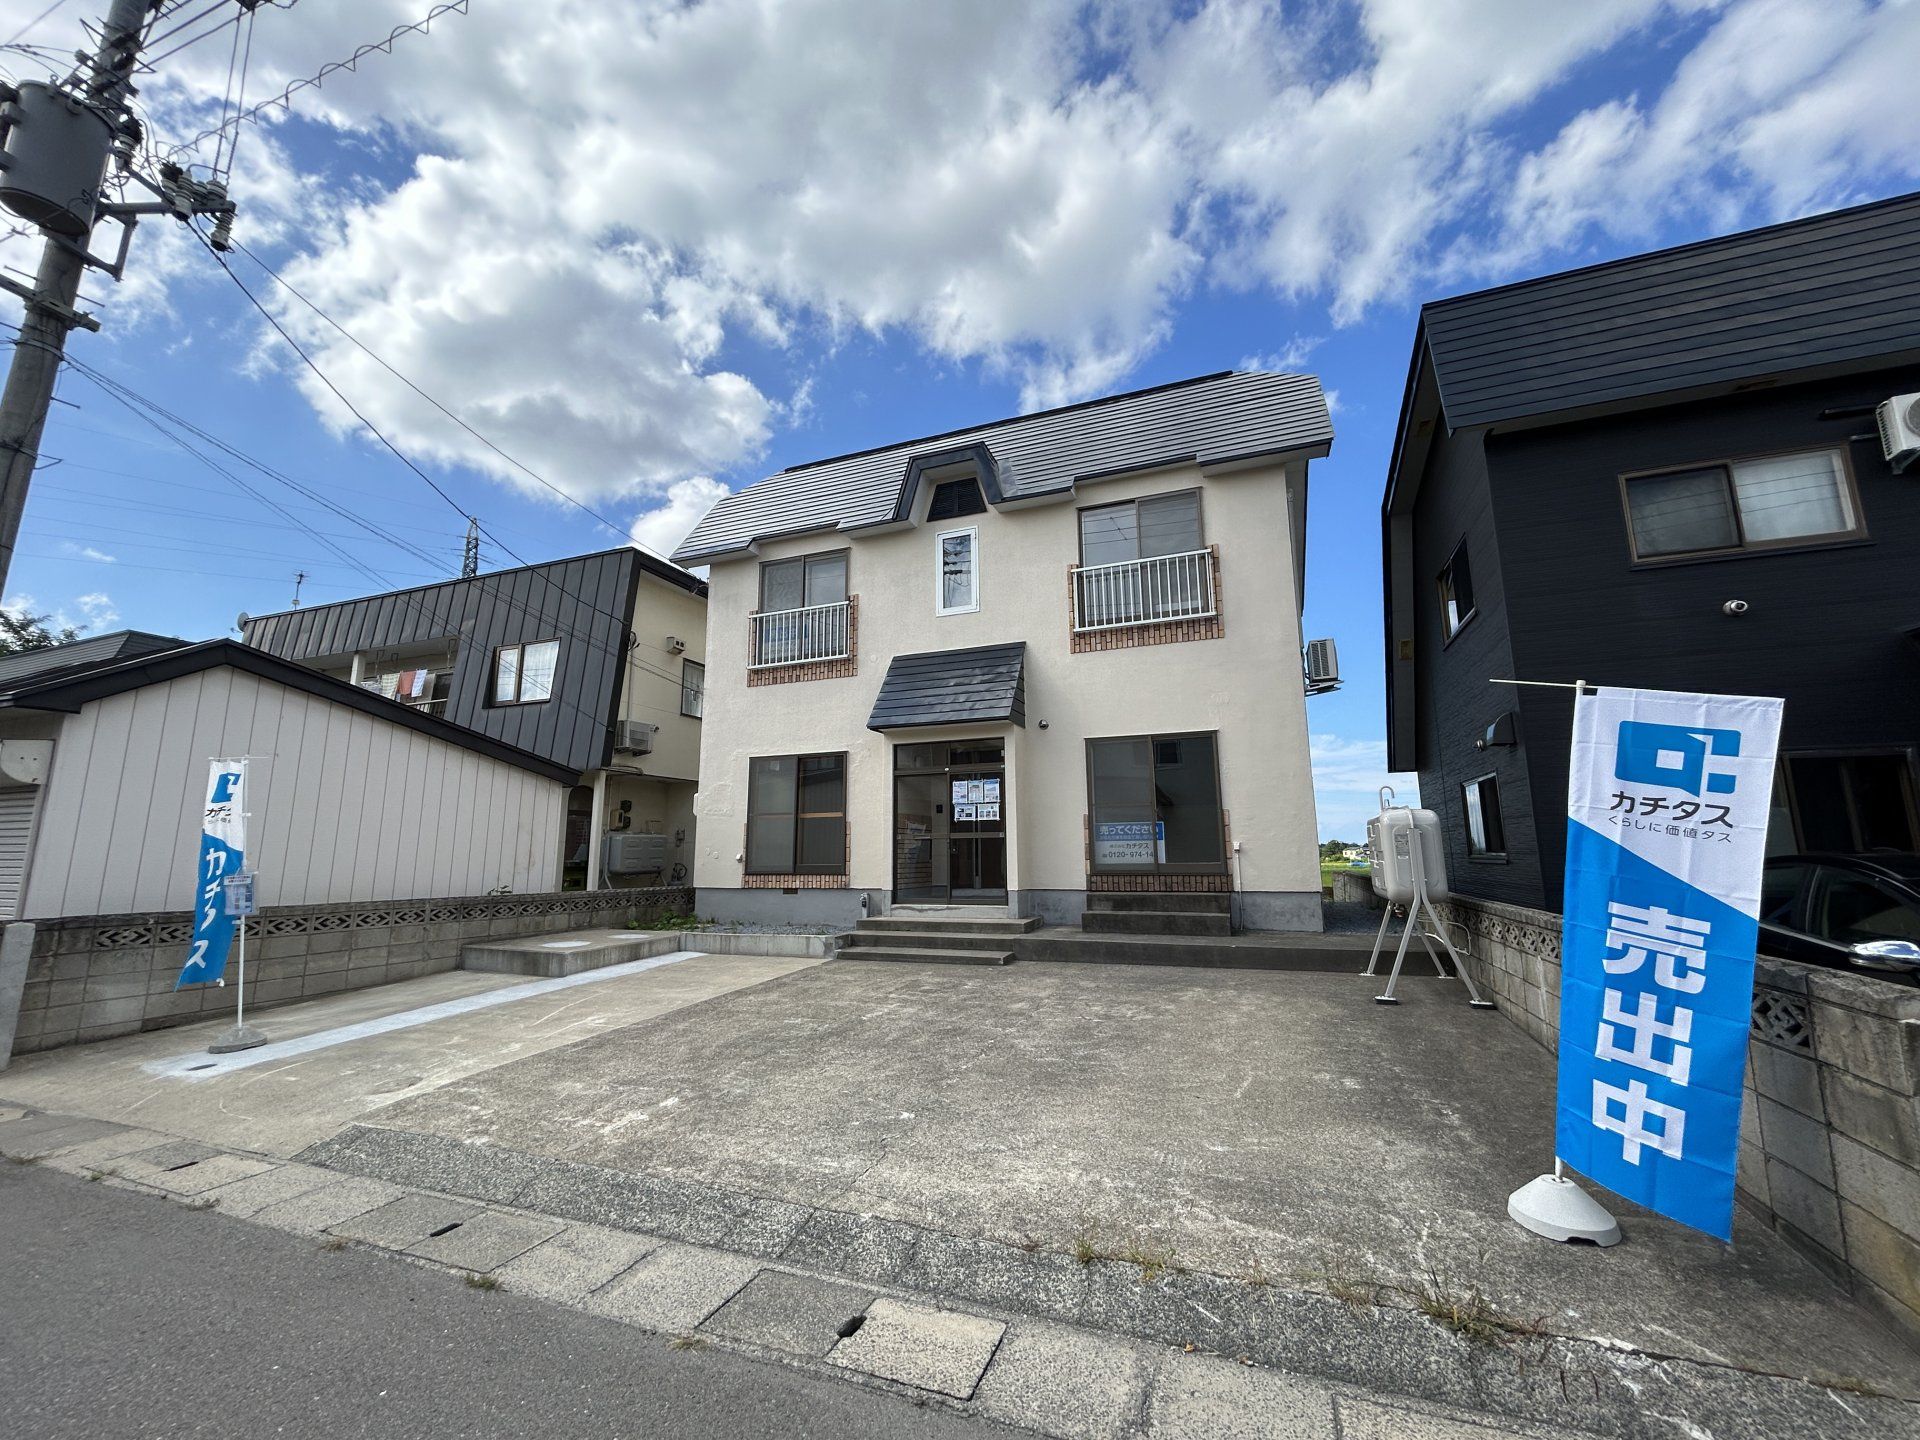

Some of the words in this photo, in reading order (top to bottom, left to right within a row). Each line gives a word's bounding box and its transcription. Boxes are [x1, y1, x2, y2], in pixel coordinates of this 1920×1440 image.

[1608, 815, 1732, 843] くらしに価値タス
[1609, 790, 1734, 829] カチタス
[1592, 901, 1711, 1166] 売出中
